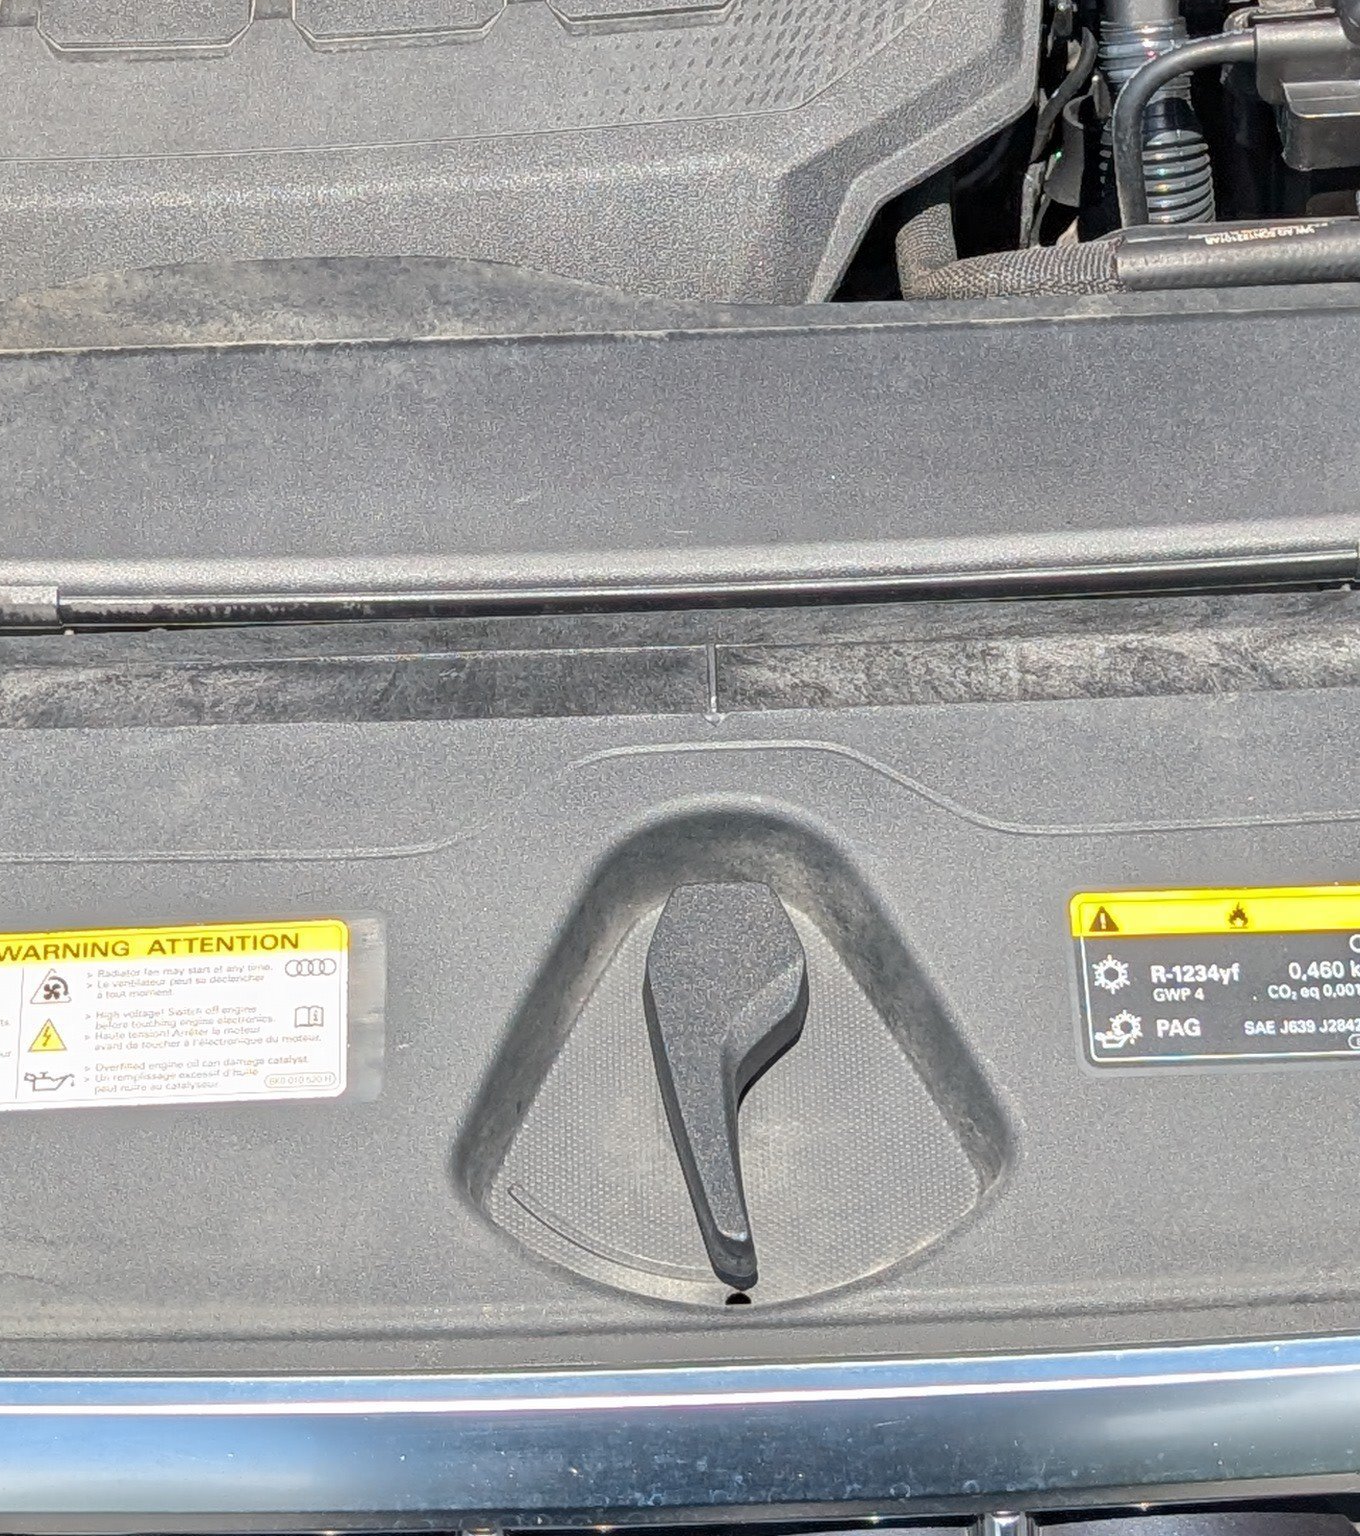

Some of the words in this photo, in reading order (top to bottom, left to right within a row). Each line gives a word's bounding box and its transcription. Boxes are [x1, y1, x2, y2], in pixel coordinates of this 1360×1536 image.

[147, 932, 299, 956] ATTENTION
[97, 968, 140, 978] Radiator
[143, 968, 160, 977] fan
[163, 967, 184, 977] may
[188, 966, 210, 975] start
[226, 965, 245, 974] any
[1150, 963, 1240, 986] R-1234yf
[1288, 961, 1345, 981] 0,460
[105, 990, 126, 999] tout
[1153, 988, 1190, 1002] GWP
[1194, 989, 1205, 1001] 4
[1301, 987, 1321, 1001] eq
[95, 1011, 120, 1022] High
[168, 1007, 202, 1016] Switch
[205, 1005, 219, 1015] off
[221, 1007, 257, 1015] engine
[95, 1021, 128, 1031] before
[131, 1018, 176, 1029] touching
[180, 1018, 214, 1028] engine
[1155, 1017, 1201, 1038] PAG
[1244, 1021, 1276, 1036] SAE
[1279, 1019, 1315, 1034] J639
[95, 1030, 125, 1040] Haute
[223, 1026, 261, 1034] moteur
[94, 1041, 123, 1051] avant
[141, 1038, 181, 1049] toucher
[148, 1062, 184, 1071] engine
[202, 1059, 220, 1068] can
[224, 1058, 264, 1068] damage
[113, 1072, 175, 1083] remplissage
